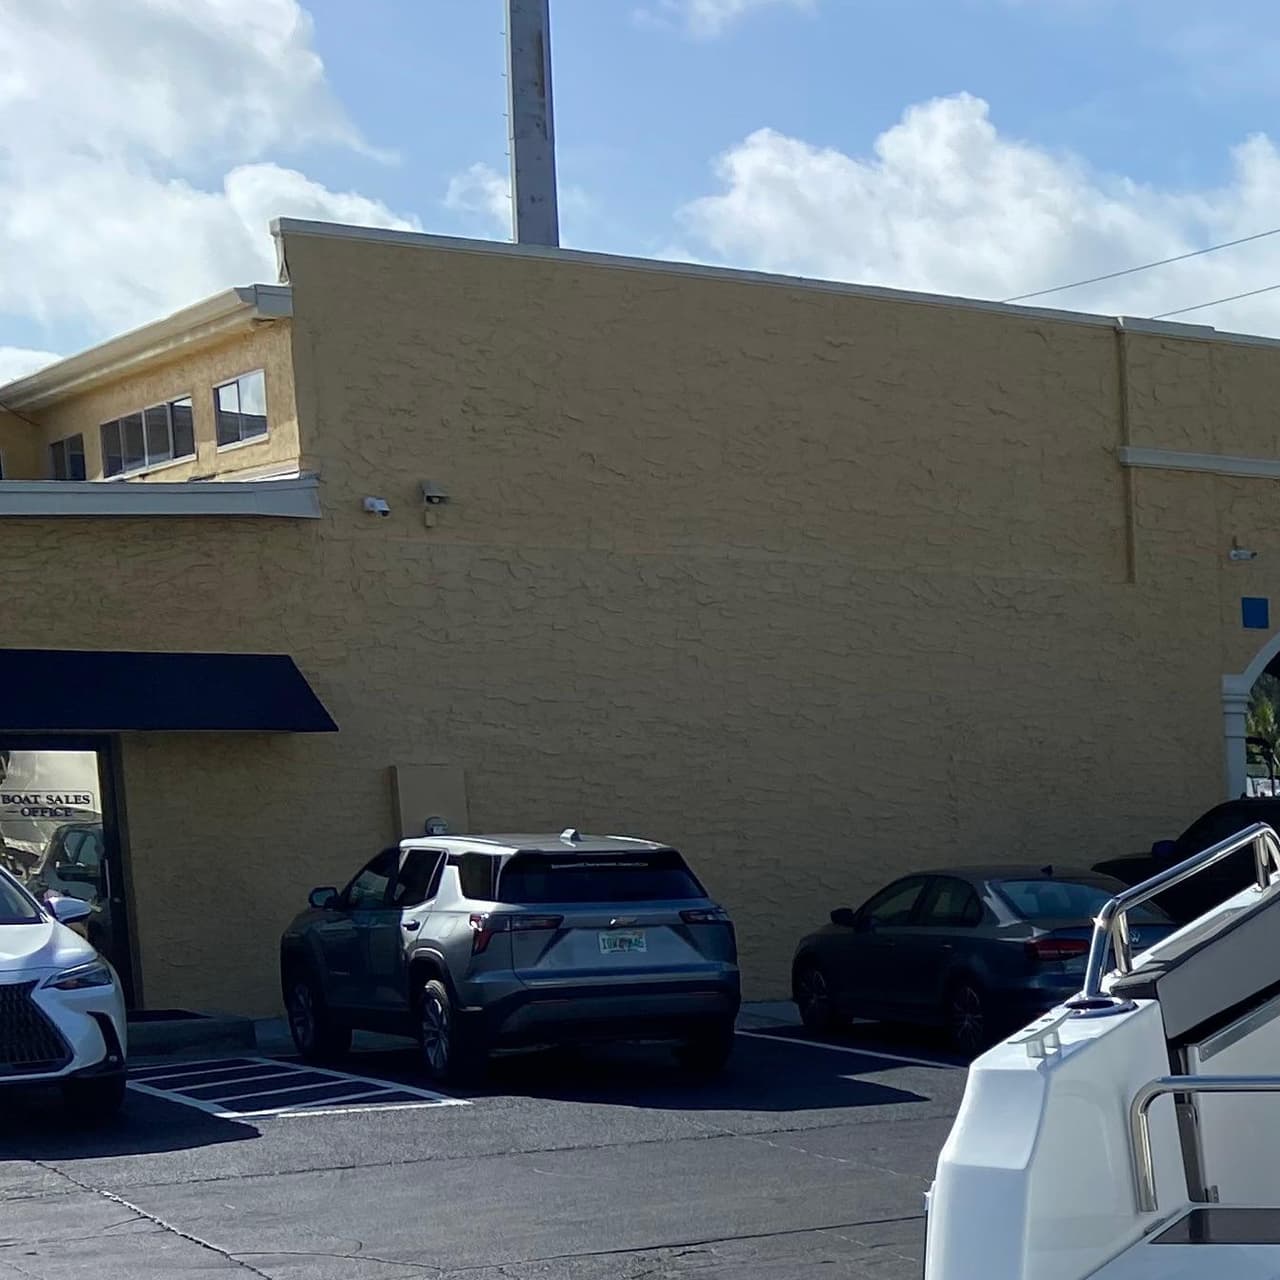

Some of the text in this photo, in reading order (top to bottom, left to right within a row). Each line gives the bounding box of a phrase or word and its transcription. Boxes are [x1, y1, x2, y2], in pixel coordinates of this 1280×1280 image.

[1, 794, 91, 805] BOAT SALES
[21, 807, 73, 817] OFFICE
